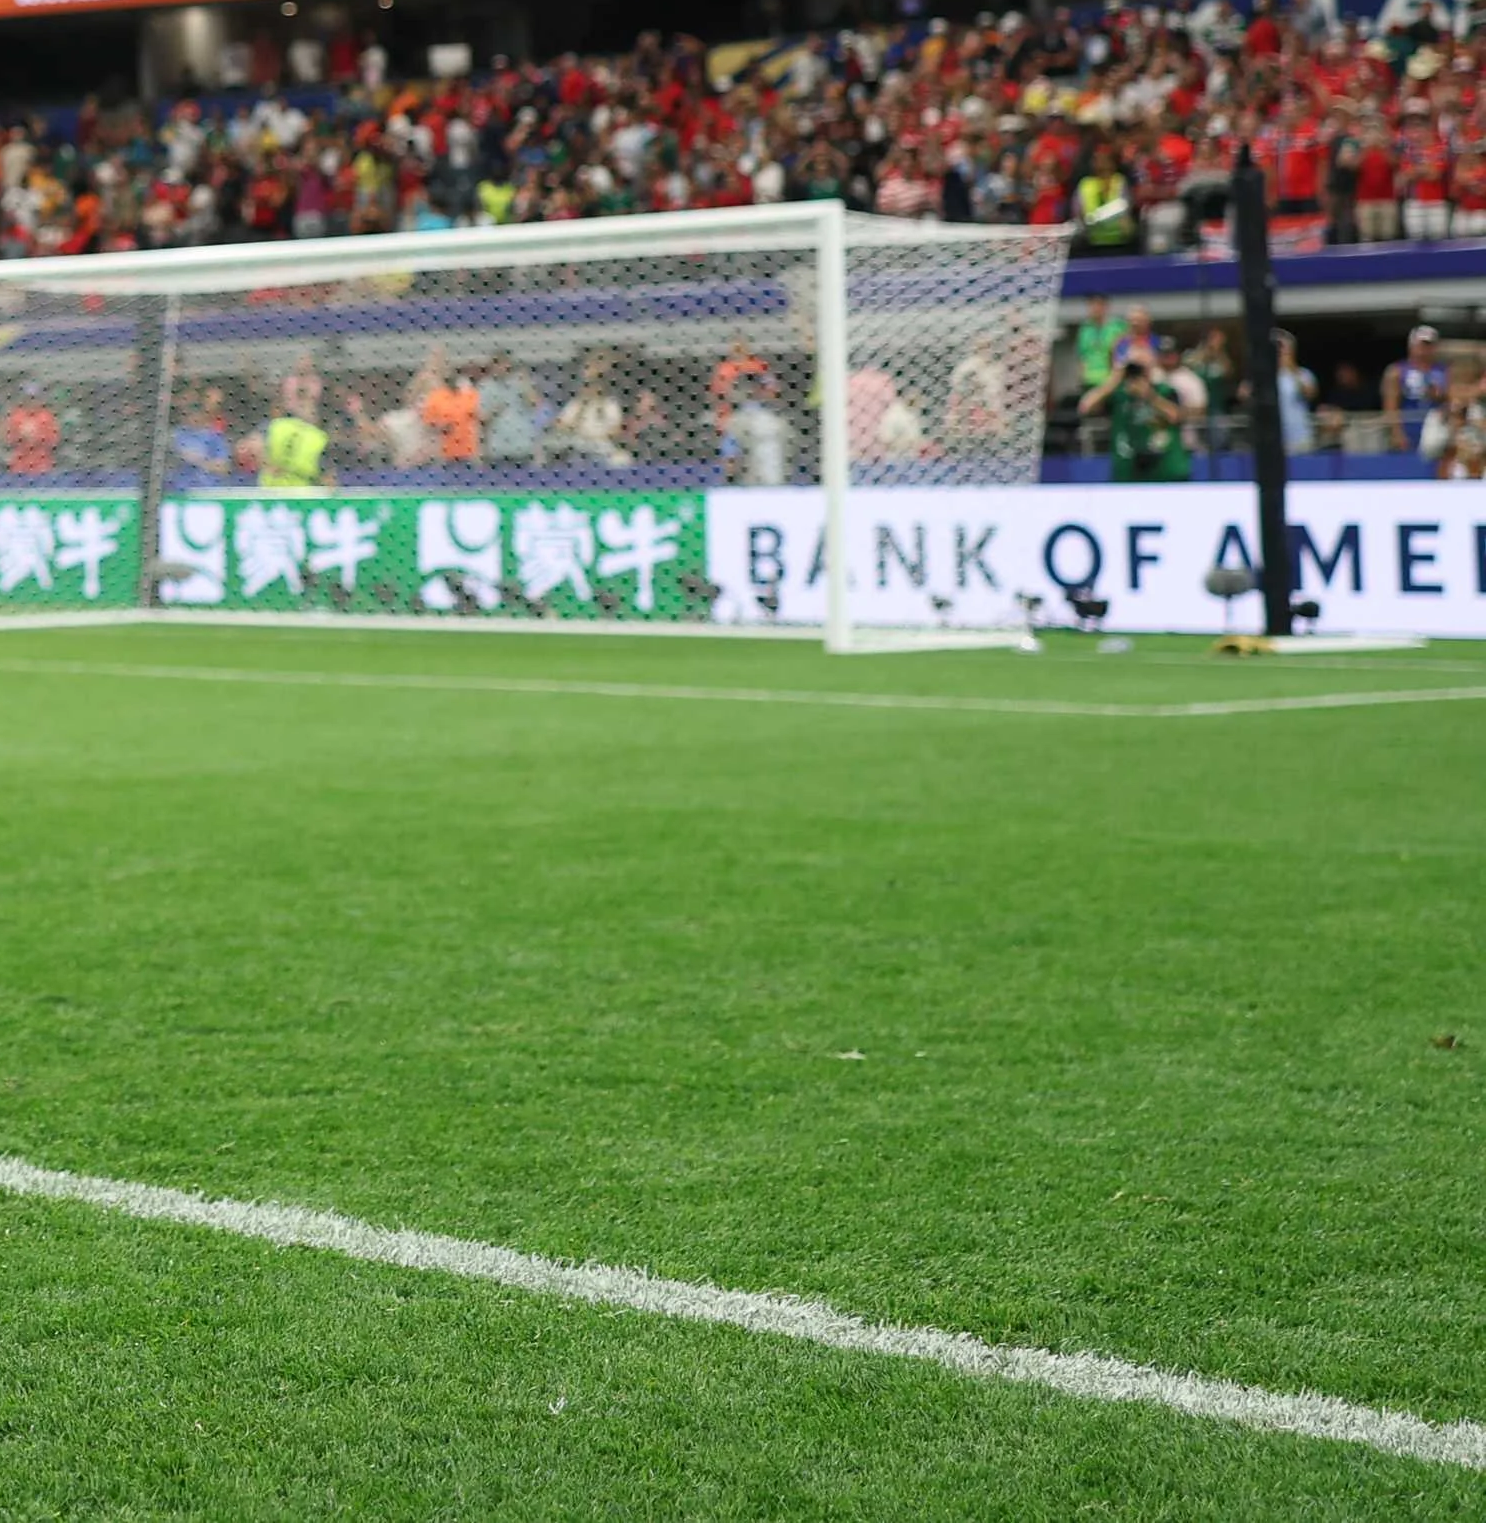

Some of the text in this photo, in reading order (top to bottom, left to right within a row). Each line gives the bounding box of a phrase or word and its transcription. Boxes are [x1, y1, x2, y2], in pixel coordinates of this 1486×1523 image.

[233, 501, 377, 596] 蒙牛
[512, 499, 680, 612] 蒙牛
[1042, 522, 1168, 592] OF
[1207, 523, 1486, 593] AME
